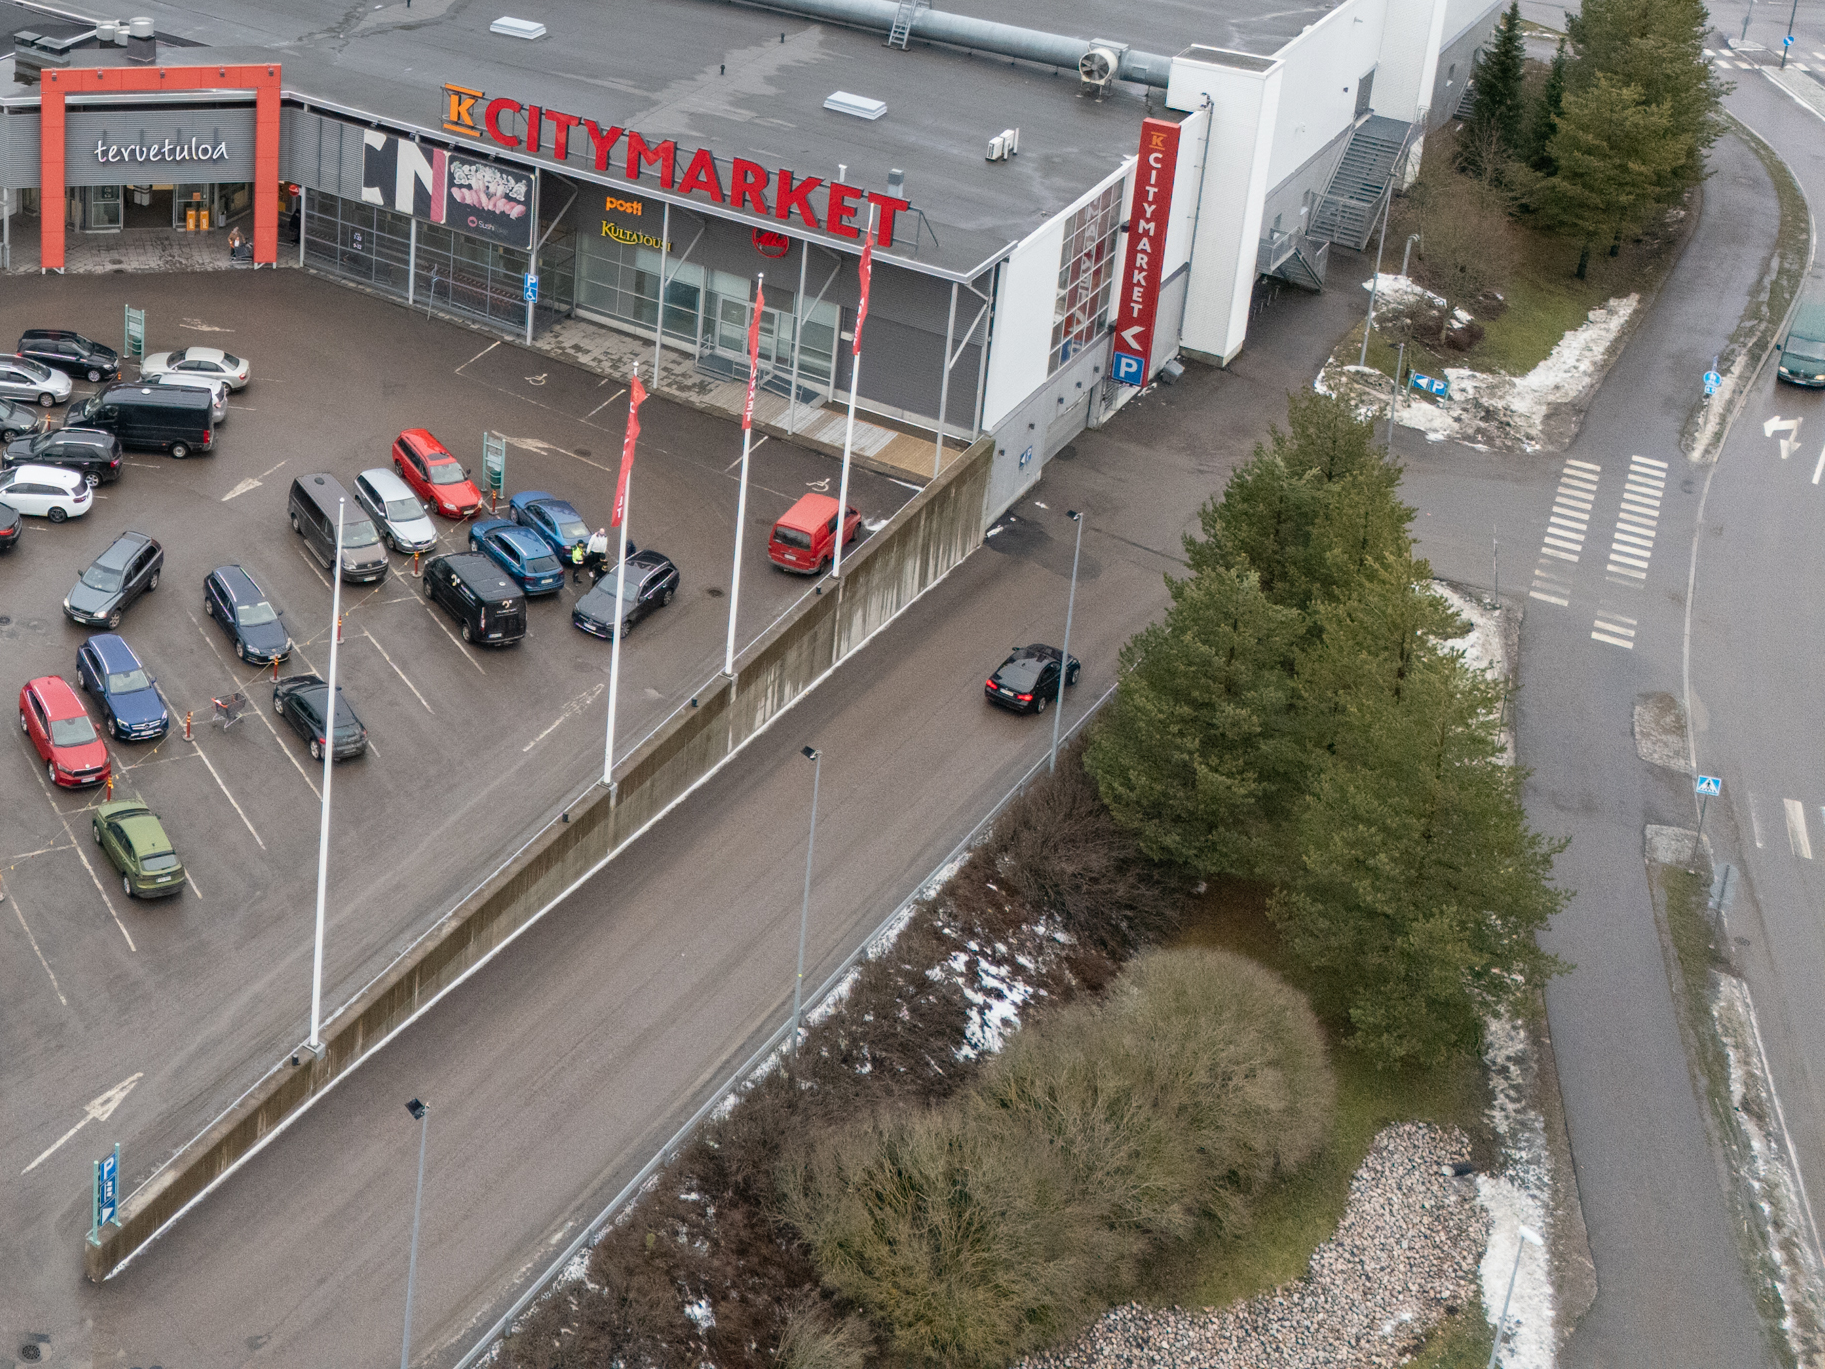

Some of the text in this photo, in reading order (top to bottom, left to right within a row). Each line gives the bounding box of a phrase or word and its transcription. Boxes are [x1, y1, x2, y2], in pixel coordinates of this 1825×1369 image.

[94, 137, 229, 162] tervetuloa
[485, 98, 910, 248] CITYMARKET
[606, 196, 642, 216] posti
[1130, 152, 1163, 318] CITYMARKET
[527, 276, 537, 287] P
[1120, 357, 1139, 379] P
[1432, 381, 1444, 393] P
[104, 1157, 114, 1180] P
